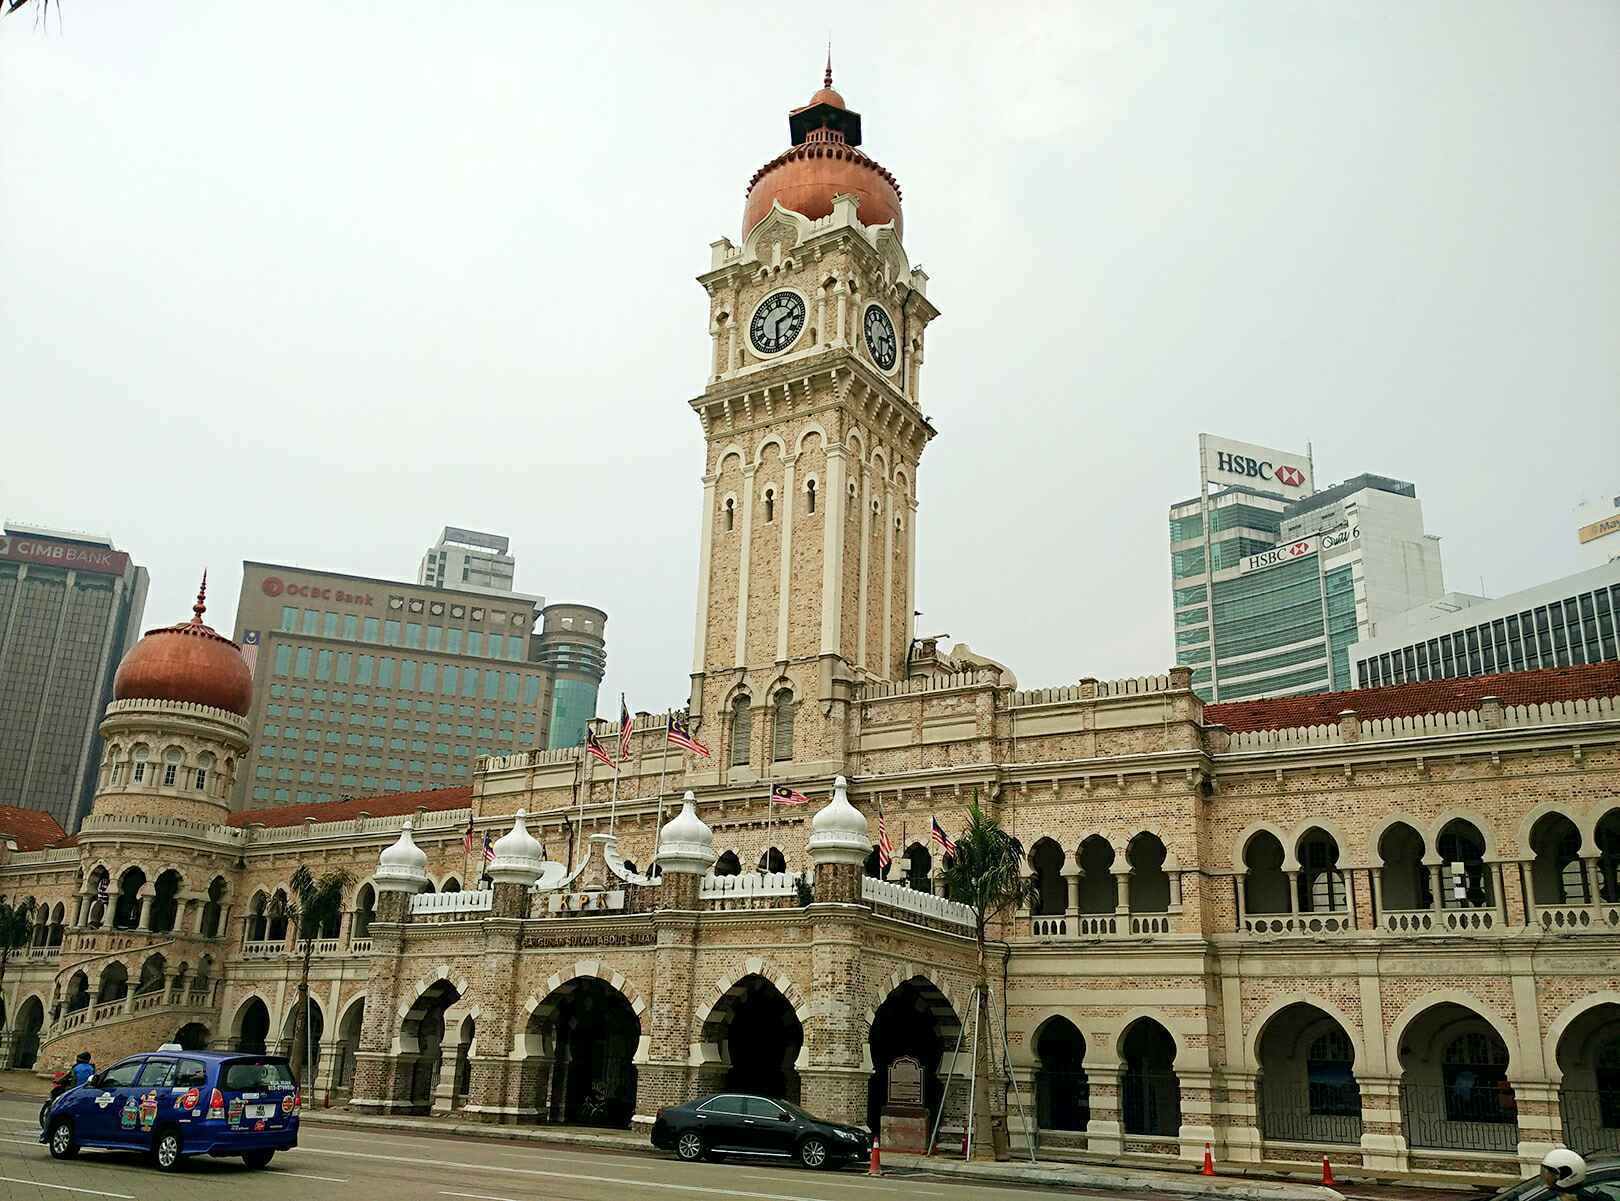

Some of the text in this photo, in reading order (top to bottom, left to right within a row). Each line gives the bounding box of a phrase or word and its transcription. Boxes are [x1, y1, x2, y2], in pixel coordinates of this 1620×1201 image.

[1217, 451, 1273, 480] HSBC
[1352, 525, 1360, 538] 6
[17, 542, 112, 566] CIMB BANK
[1249, 548, 1287, 569] HSBC
[286, 583, 374, 607] OCBC Bank
